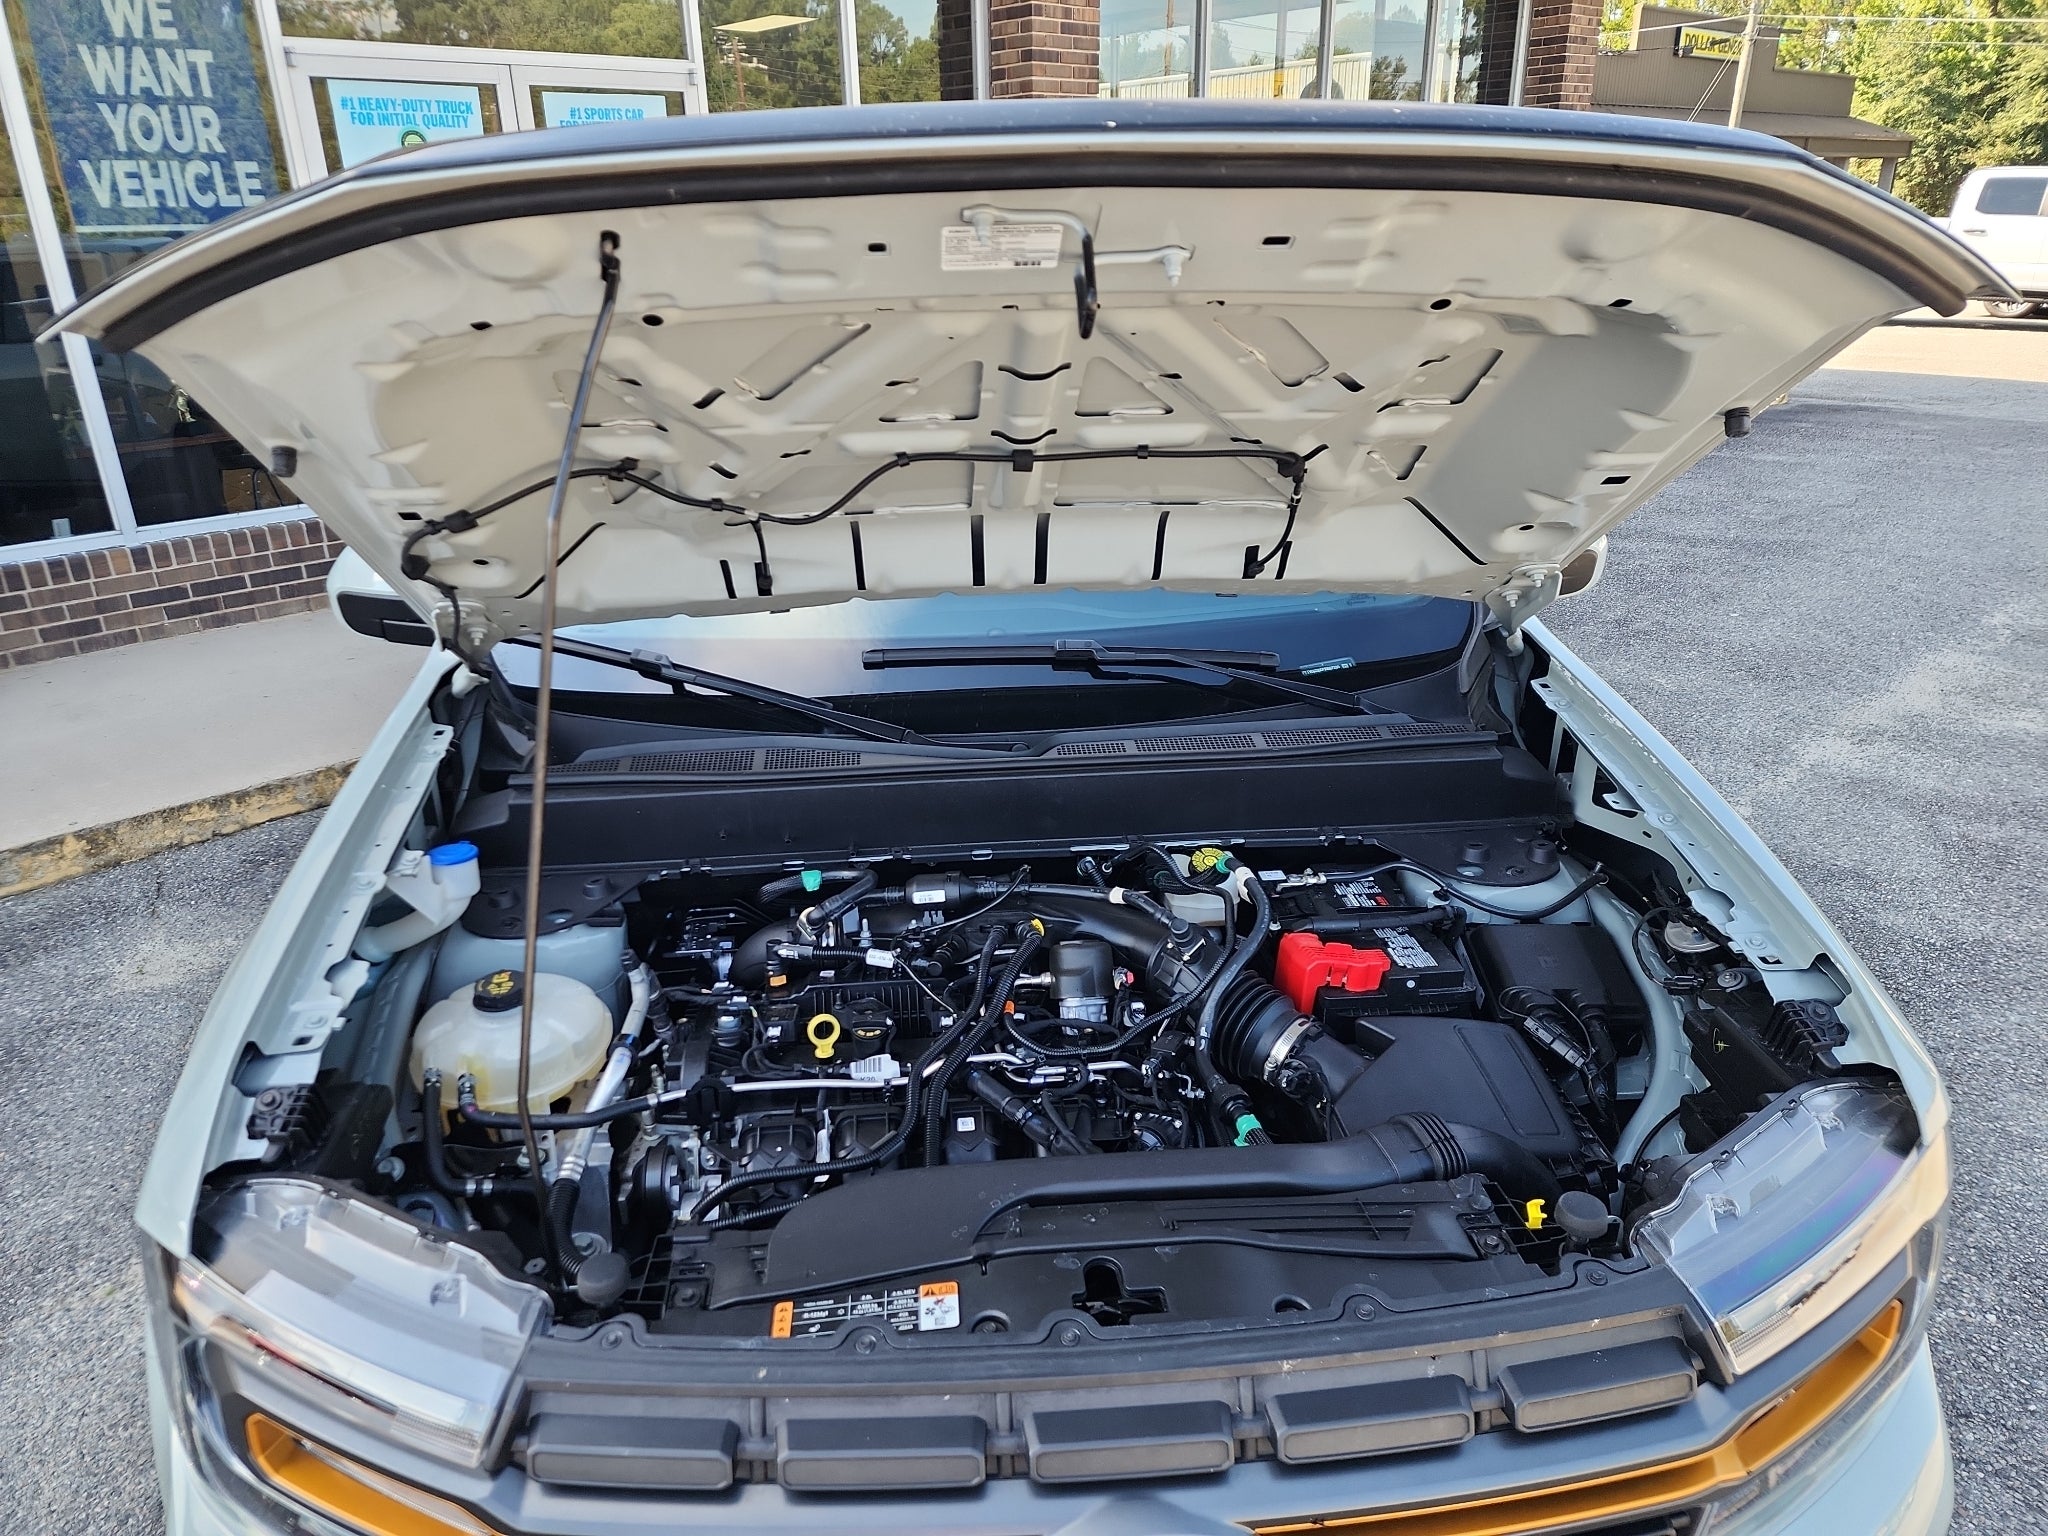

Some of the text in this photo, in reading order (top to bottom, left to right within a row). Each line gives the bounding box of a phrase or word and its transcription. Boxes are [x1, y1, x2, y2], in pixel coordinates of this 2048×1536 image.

[102, 0, 178, 40] WE
[77, 44, 214, 98] WANT
[341, 96, 474, 114] #1 HEAVY-DUTY TRUCK
[350, 111, 469, 130] FOR INITIAL QUALITY
[570, 107, 644, 121] #1 SPORTS CAR
[96, 103, 226, 153] YOUR
[78, 159, 266, 209] VEHICLE
